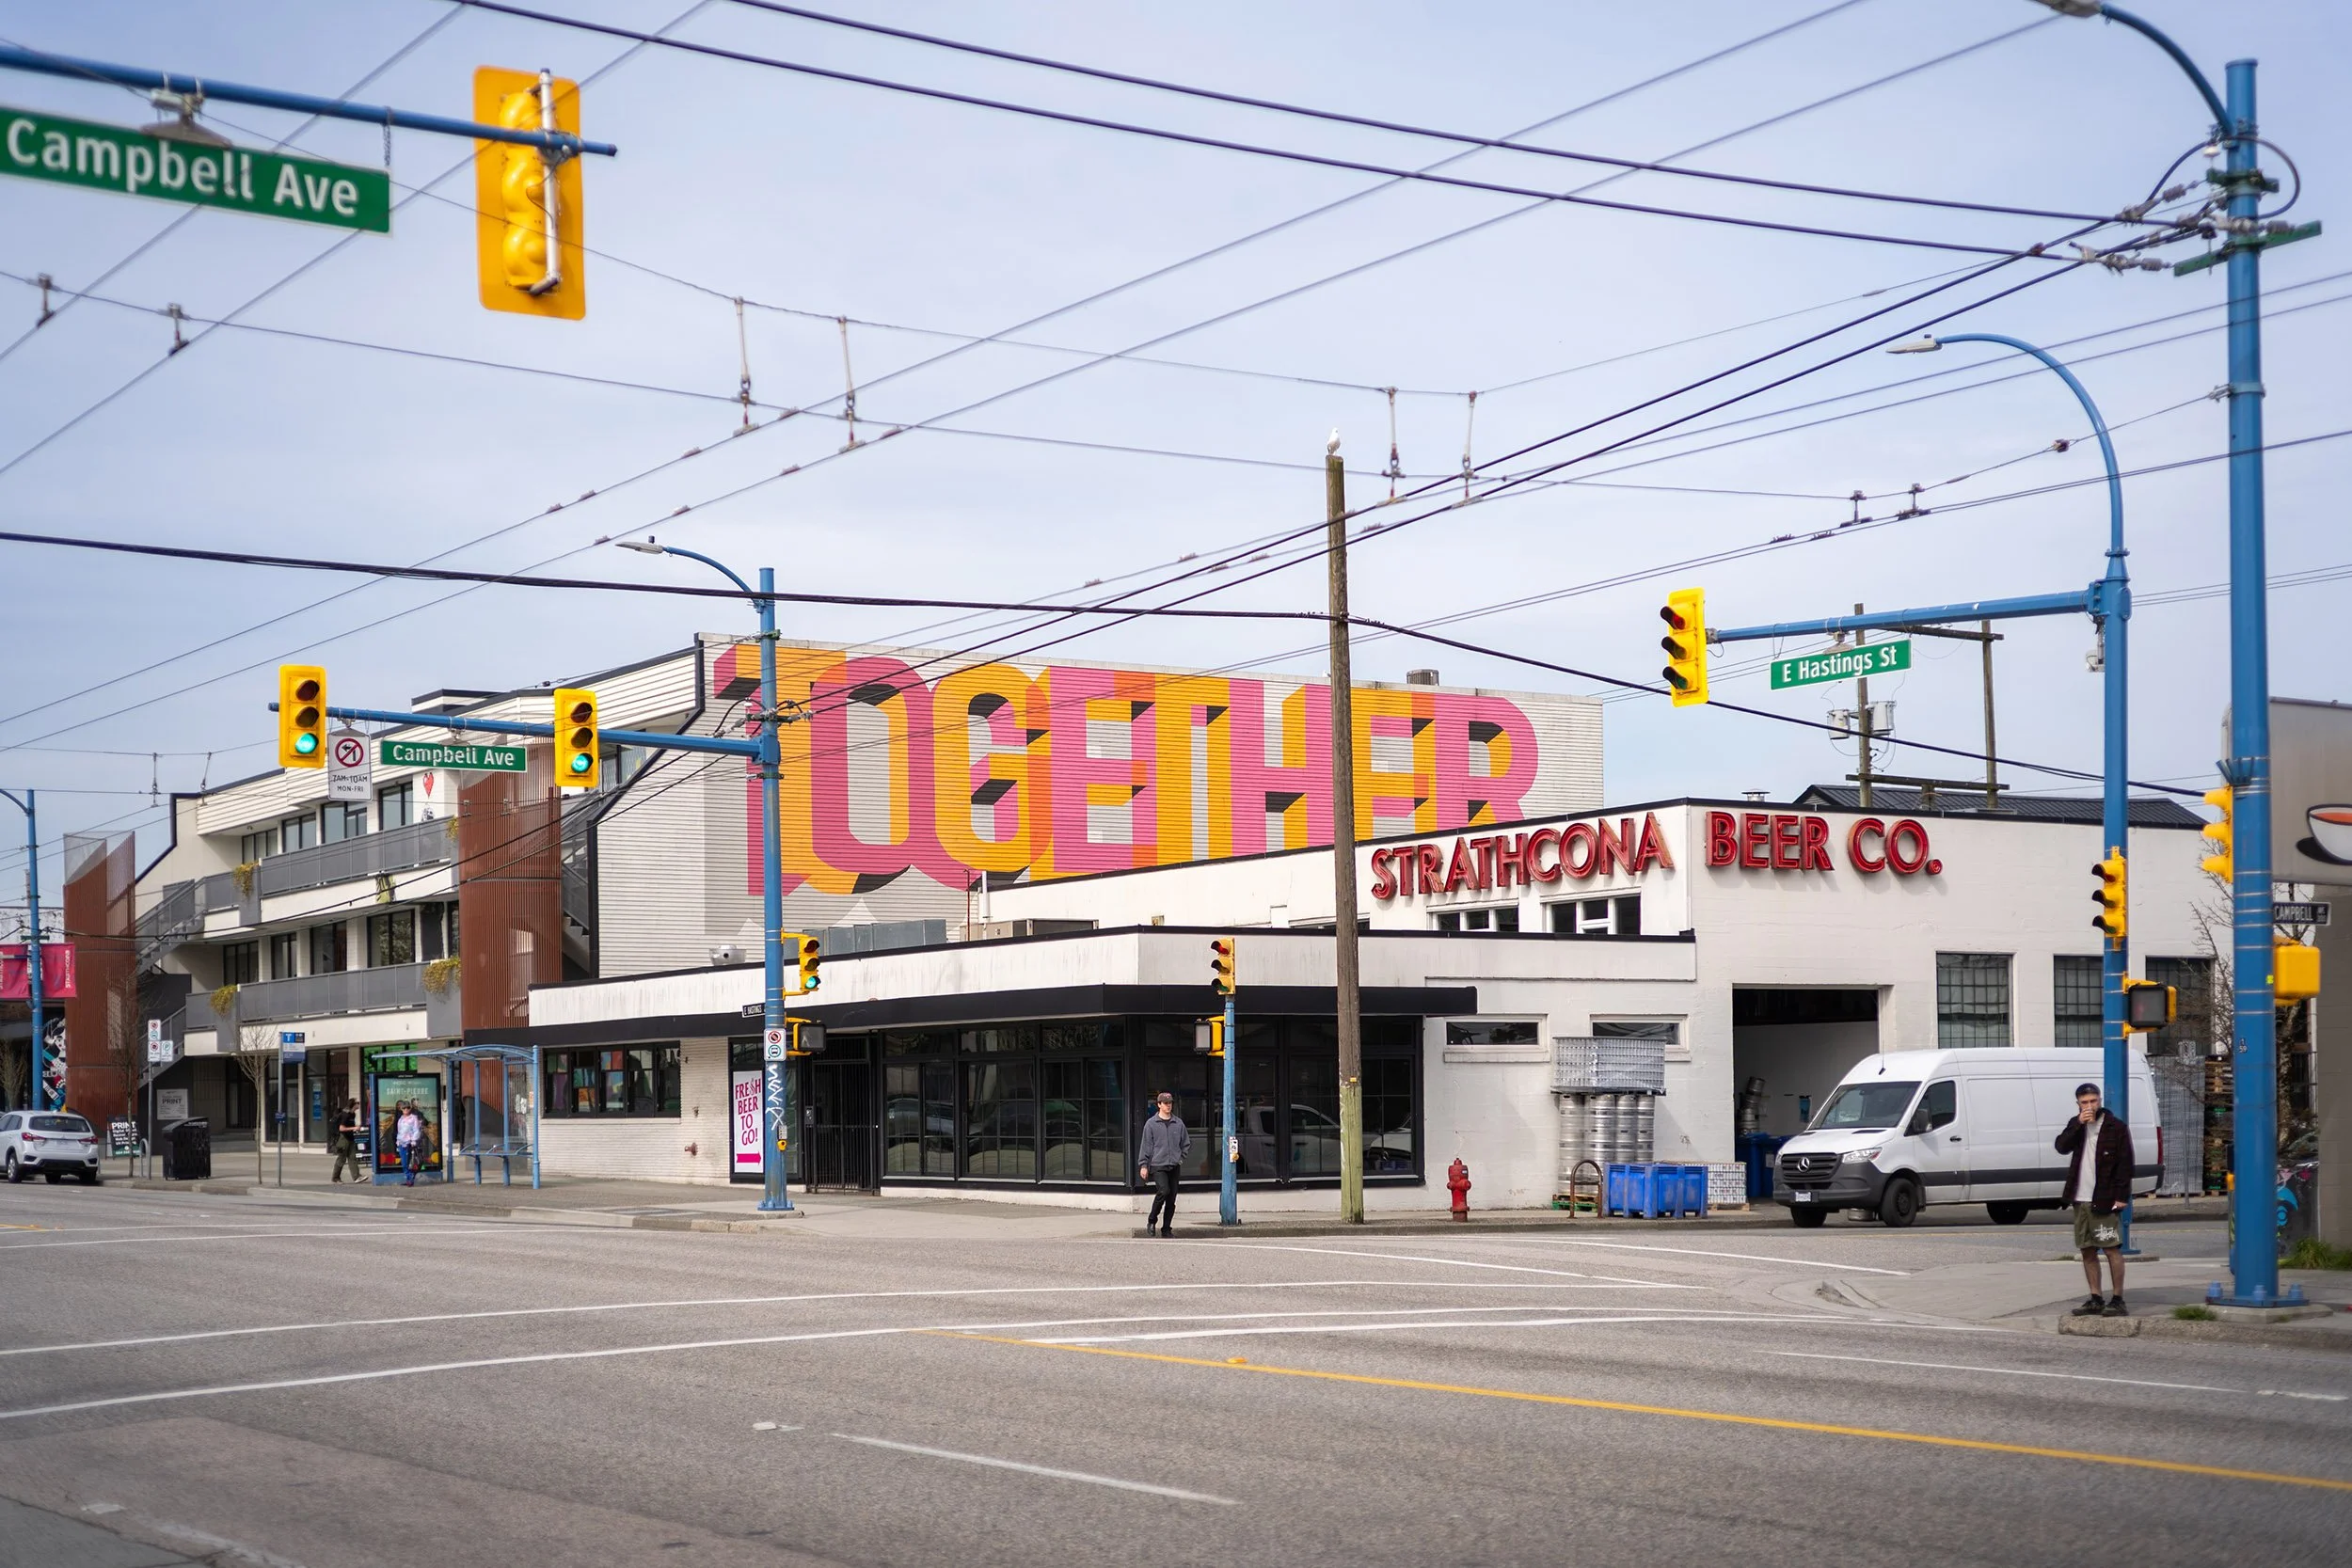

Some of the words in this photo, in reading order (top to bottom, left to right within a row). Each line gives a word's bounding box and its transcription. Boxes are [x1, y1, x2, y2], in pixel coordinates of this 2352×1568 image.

[7, 118, 253, 200] Campbell
[273, 166, 359, 216] Ave
[1782, 663, 1792, 683] E
[1798, 653, 1873, 679] Hastings
[1879, 645, 1898, 668] St
[392, 744, 478, 767] Campbell
[484, 749, 515, 766] Ave
[713, 641, 1539, 896] TOGETHER
[1371, 811, 1675, 900] STRATHCONA
[1705, 811, 1835, 871] BEER
[1847, 816, 1944, 876] CO.
[2274, 905, 2313, 921] CAMPBELL
[738, 1096, 759, 1116] BEER
[740, 1115, 754, 1129] TO
[741, 1128, 758, 1146] GO!
